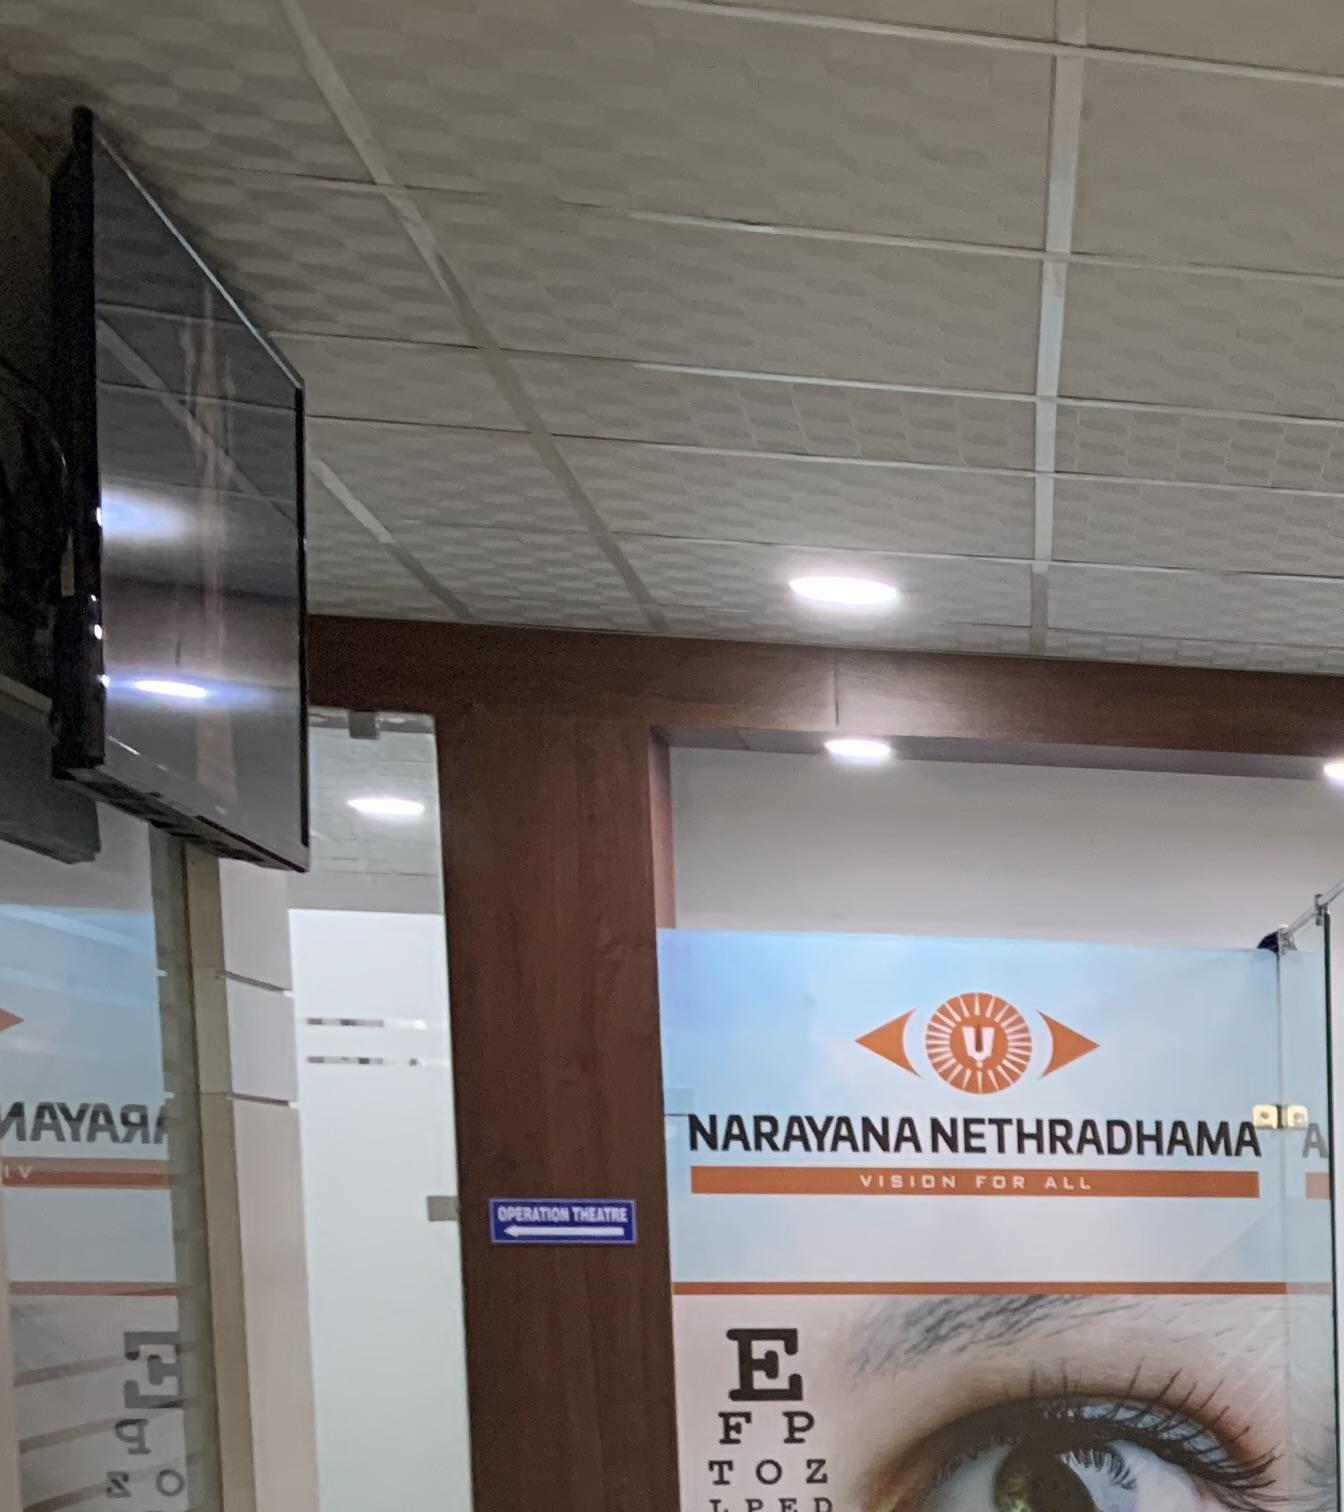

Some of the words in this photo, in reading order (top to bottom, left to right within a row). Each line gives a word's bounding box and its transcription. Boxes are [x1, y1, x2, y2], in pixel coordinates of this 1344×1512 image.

[688, 1114, 923, 1153] NARAYANA
[930, 1117, 1262, 1158] NETHRADHAMA
[860, 1175, 957, 1189] VISION
[976, 1176, 1025, 1190] FOR
[1045, 1176, 1092, 1191] ALL
[497, 1206, 570, 1222] OPERATION
[572, 1206, 628, 1222] THEATRE
[726, 1328, 804, 1401] E
